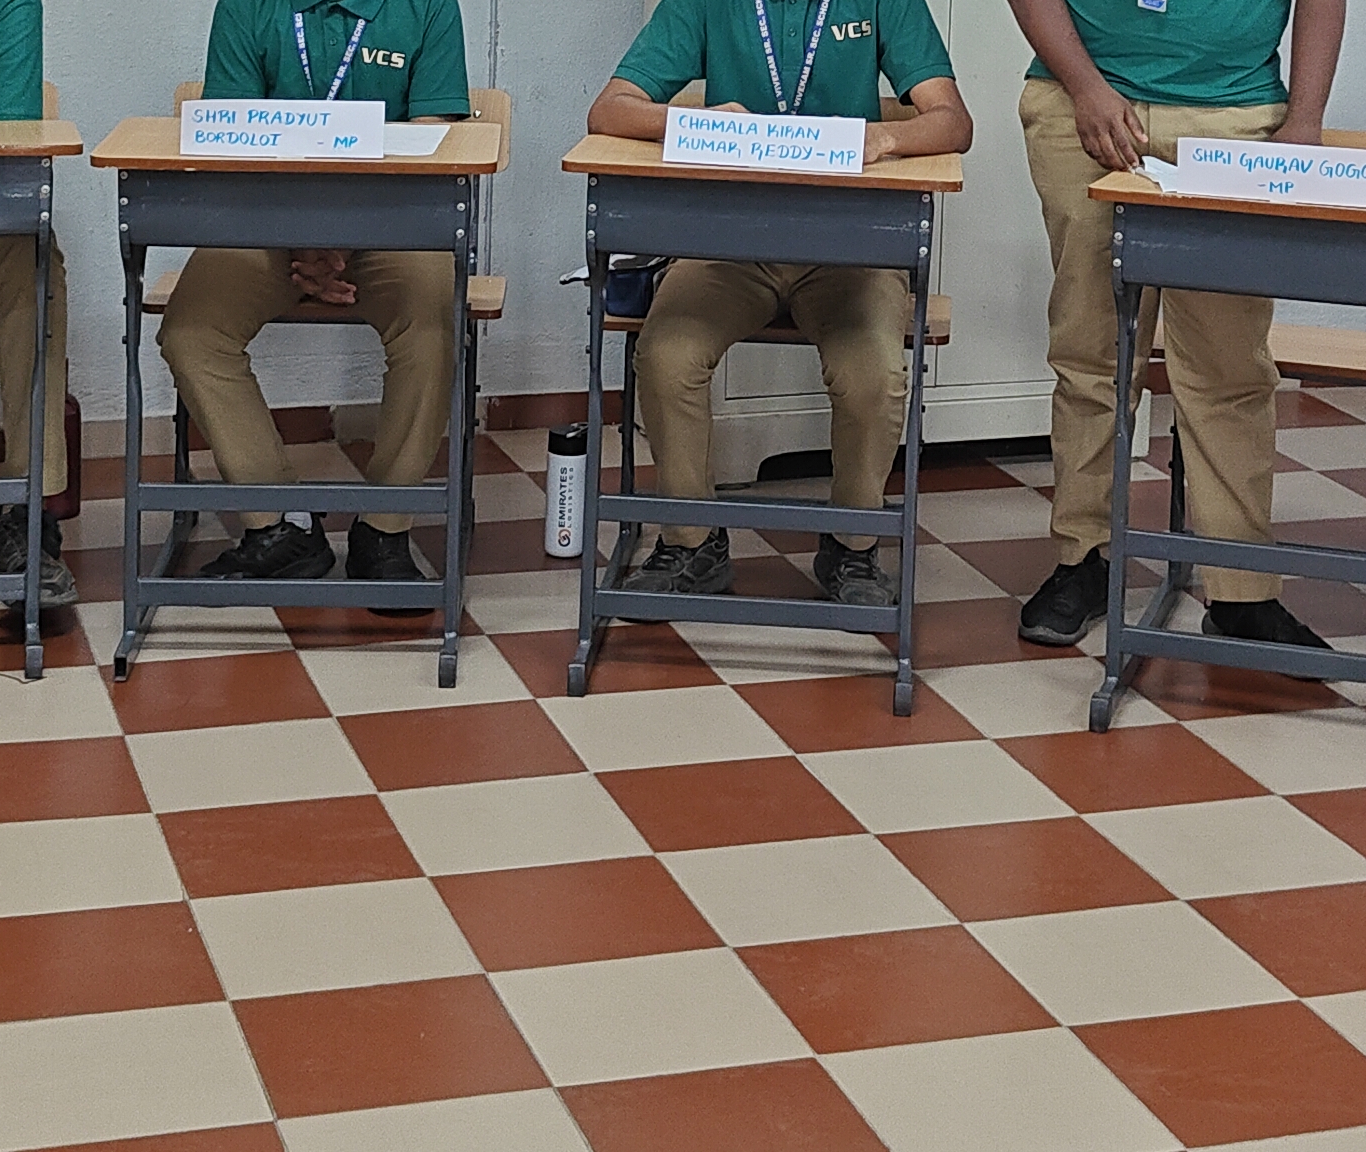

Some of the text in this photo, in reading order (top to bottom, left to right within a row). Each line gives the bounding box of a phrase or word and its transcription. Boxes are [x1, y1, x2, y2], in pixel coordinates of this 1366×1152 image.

[757, 16, 769, 37] SEC.
[831, 20, 872, 41] VCS
[762, 38, 772, 54] SR.
[361, 47, 406, 69] VCS
[792, 65, 811, 107] VIVEKAM
[805, 49, 815, 65] SR.
[810, 27, 822, 49] SEC.
[766, 54, 783, 97] VIVEKAM
[192, 109, 331, 126] SHRI PRADYUT
[678, 114, 820, 141] CHAMALA KIRAN
[195, 130, 282, 146] BORDOLOI
[678, 135, 741, 159] KUMAR
[1192, 148, 1231, 164] SHRI
[1239, 152, 1313, 174] GAURAV
[558, 467, 568, 528] EMIRATES
